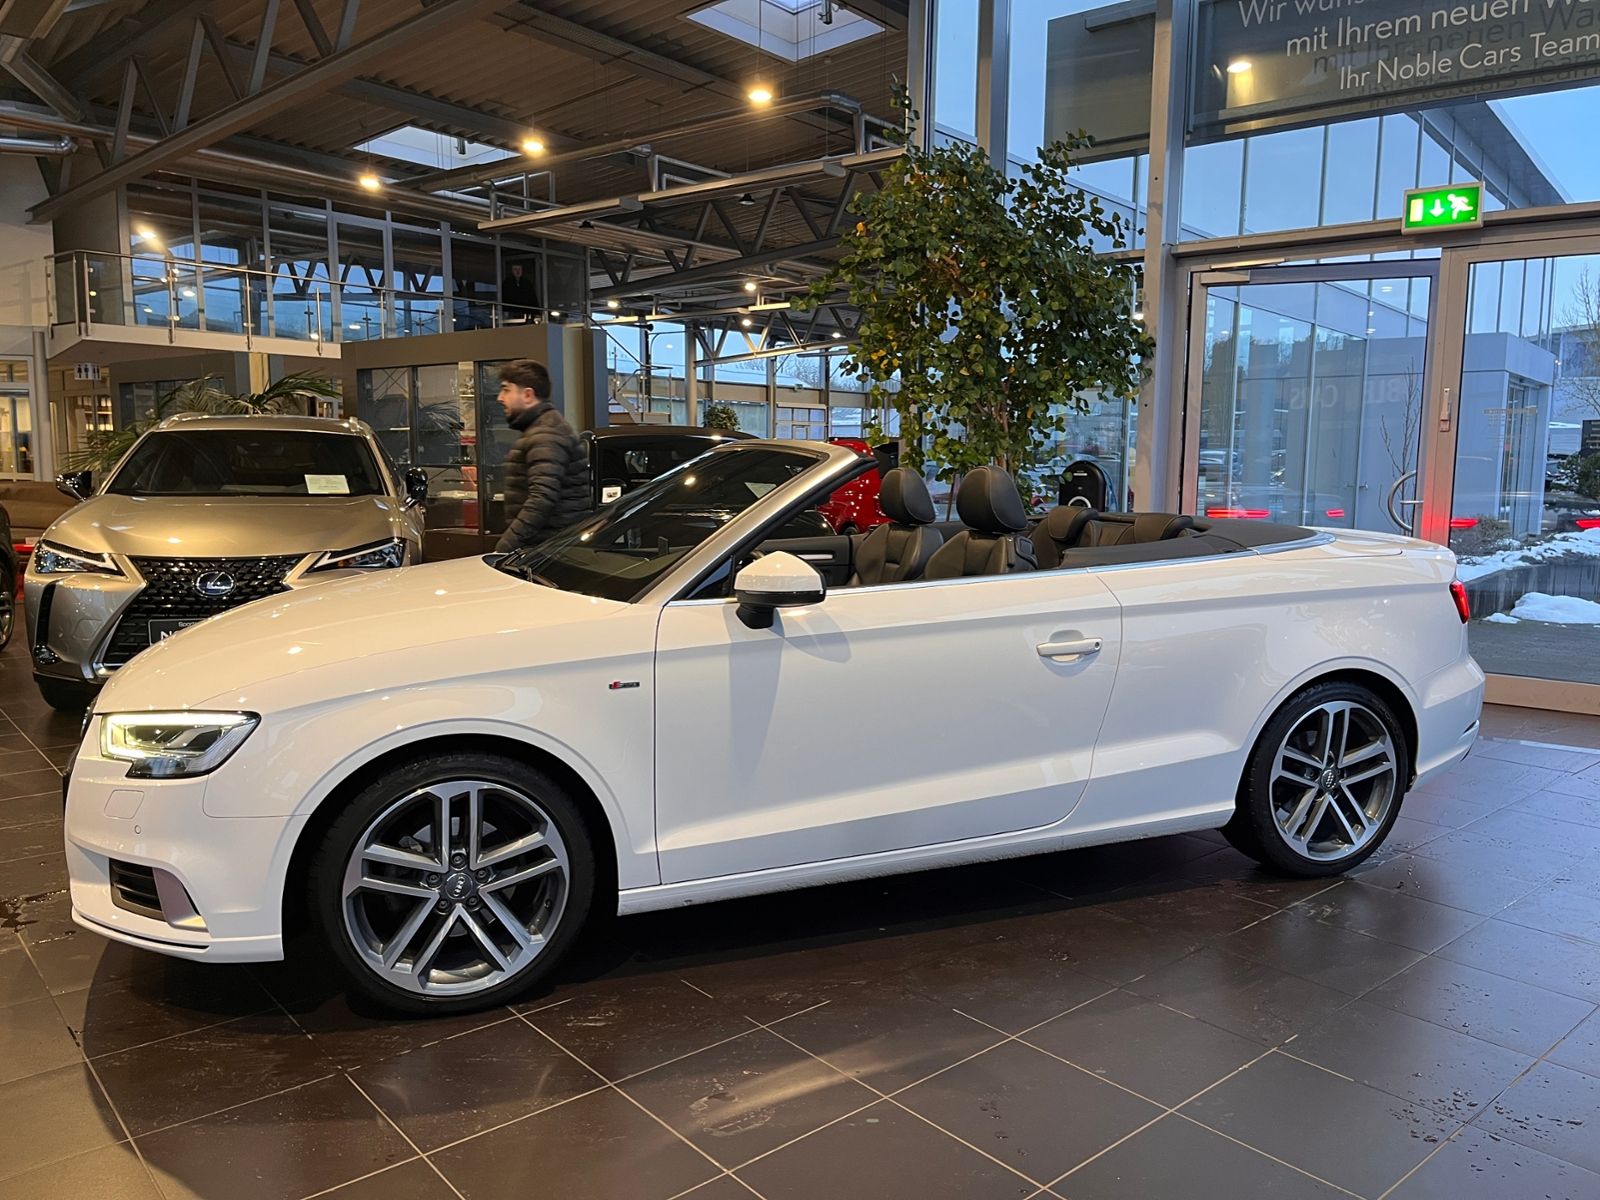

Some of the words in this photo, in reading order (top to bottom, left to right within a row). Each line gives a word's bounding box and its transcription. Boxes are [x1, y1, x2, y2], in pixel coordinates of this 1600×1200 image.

[1238, 0, 1287, 28] Wir
[1286, 25, 1328, 57] mit
[1337, 14, 1421, 48] Ihrem
[1431, 0, 1529, 30] neuen
[1340, 65, 1371, 90] Ihr
[1377, 50, 1452, 84] Noble
[1459, 43, 1521, 69] Cars
[1529, 32, 1600, 59] Team
